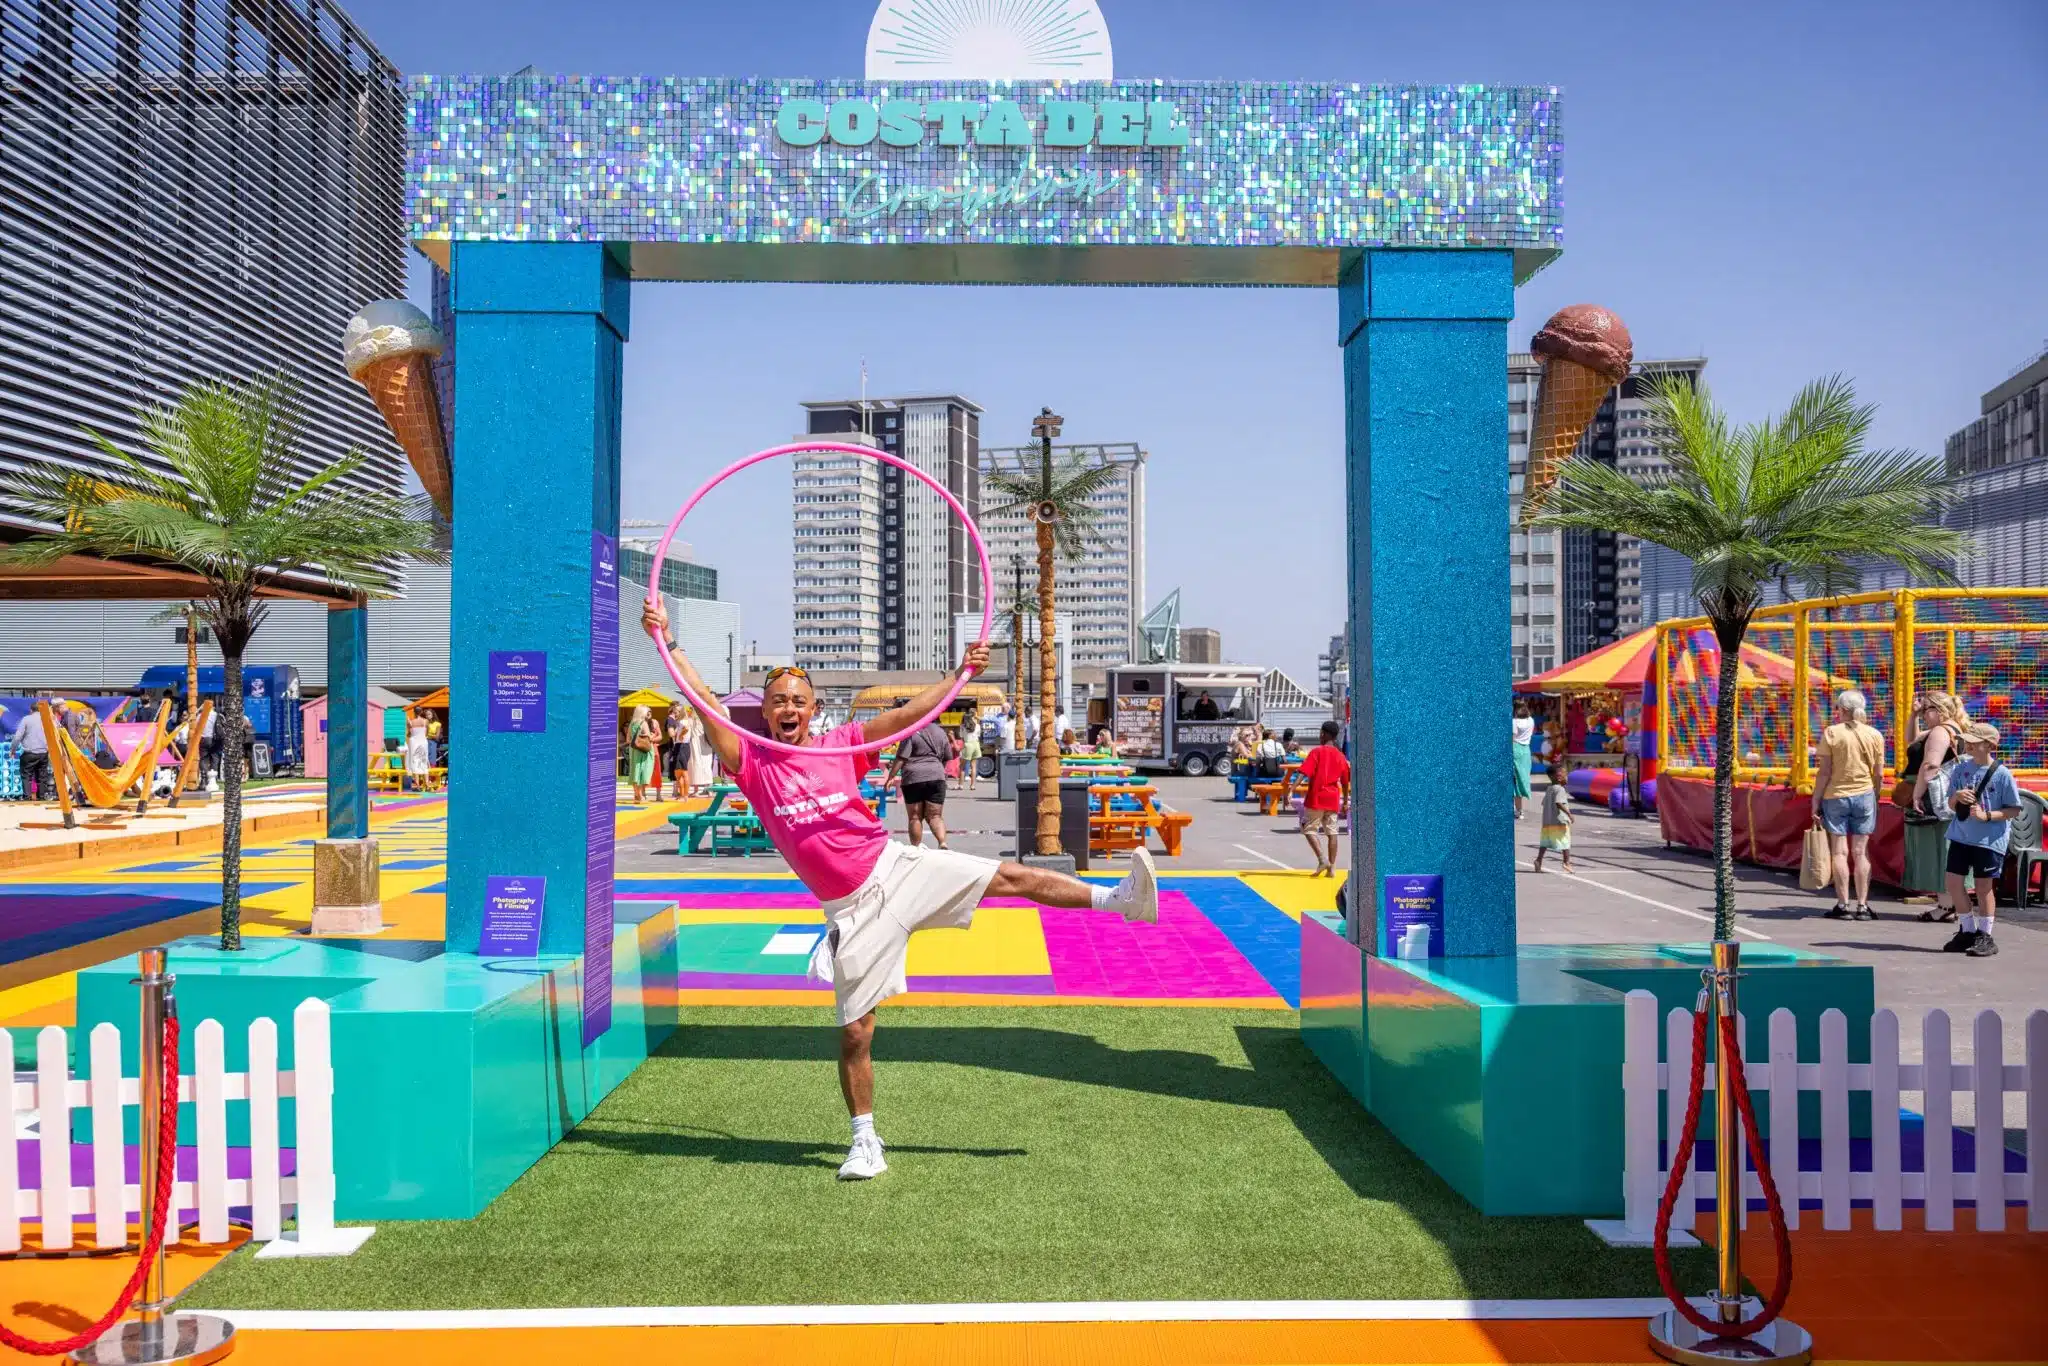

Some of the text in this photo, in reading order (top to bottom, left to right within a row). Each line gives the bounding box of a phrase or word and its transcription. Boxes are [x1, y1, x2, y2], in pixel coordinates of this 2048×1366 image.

[777, 99, 1190, 147] COSTA DEL
[842, 160, 1129, 225] Croydon
[1130, 698, 1148, 706] MENU
[1192, 726, 1218, 734] PREMIUM
[1178, 734, 1211, 743] BURGERS
[1212, 735, 1219, 743] &
[492, 896, 536, 905] Photography
[1394, 896, 1436, 904] Photography
